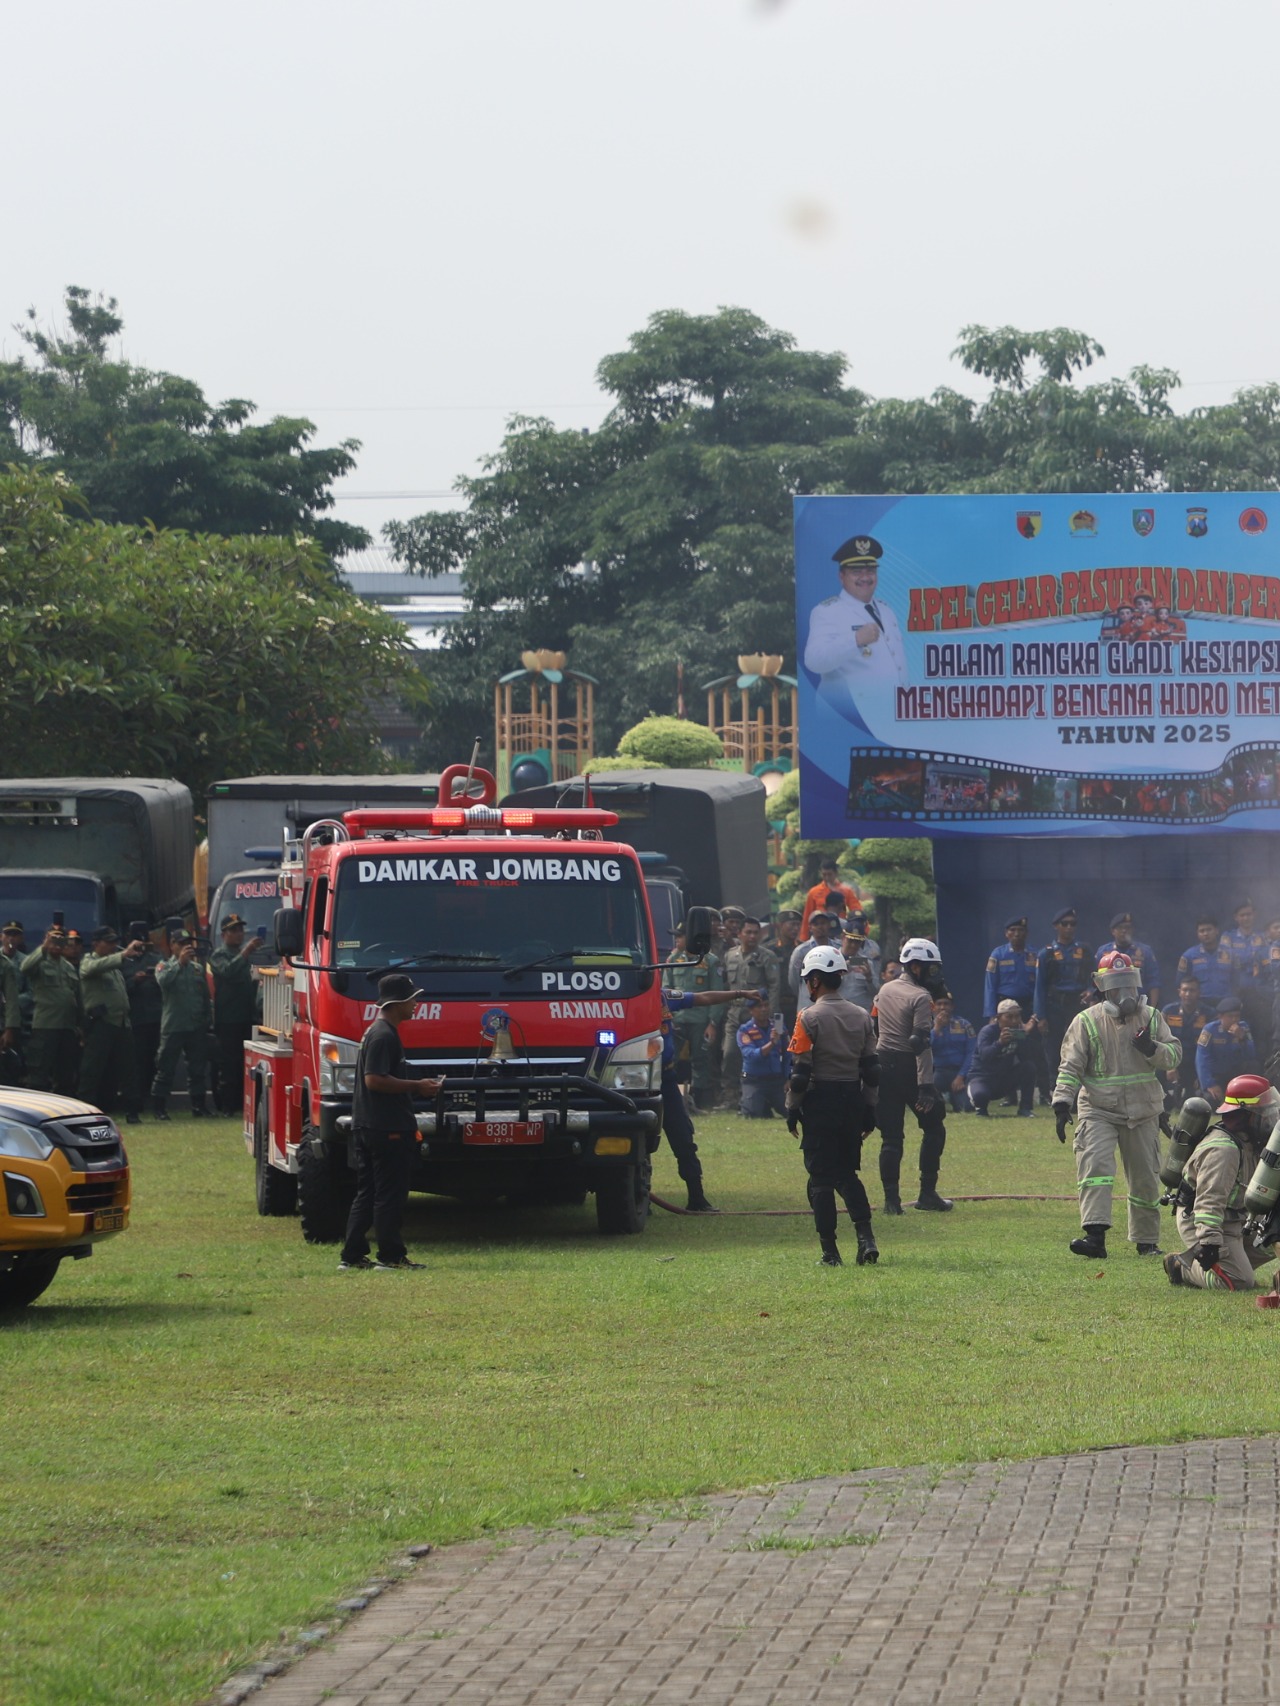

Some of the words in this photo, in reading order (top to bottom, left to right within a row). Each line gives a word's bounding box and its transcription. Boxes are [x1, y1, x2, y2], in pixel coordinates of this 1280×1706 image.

[907, 584, 973, 633] APEL
[976, 574, 1060, 628] GELAR
[1061, 566, 1173, 616] PASUKAN
[1175, 566, 1231, 615] DAN
[923, 641, 1004, 679] DALAM
[1011, 641, 1100, 678] RANGKA
[1106, 640, 1175, 676] GLADI
[894, 683, 1048, 721] MENGHADAPI
[1051, 682, 1155, 719] BENCANA
[1158, 680, 1230, 718] HIDRO
[1058, 725, 1156, 745] TAHUN
[1163, 723, 1232, 743] 2025
[358, 859, 478, 883] DAMKAR
[486, 858, 621, 882] JOMBANG
[235, 881, 277, 899] POLISI
[542, 971, 621, 991] PLOSO
[466, 1124, 473, 1137] S
[486, 1123, 514, 1137] 8381
[526, 1122, 542, 1136] WP
